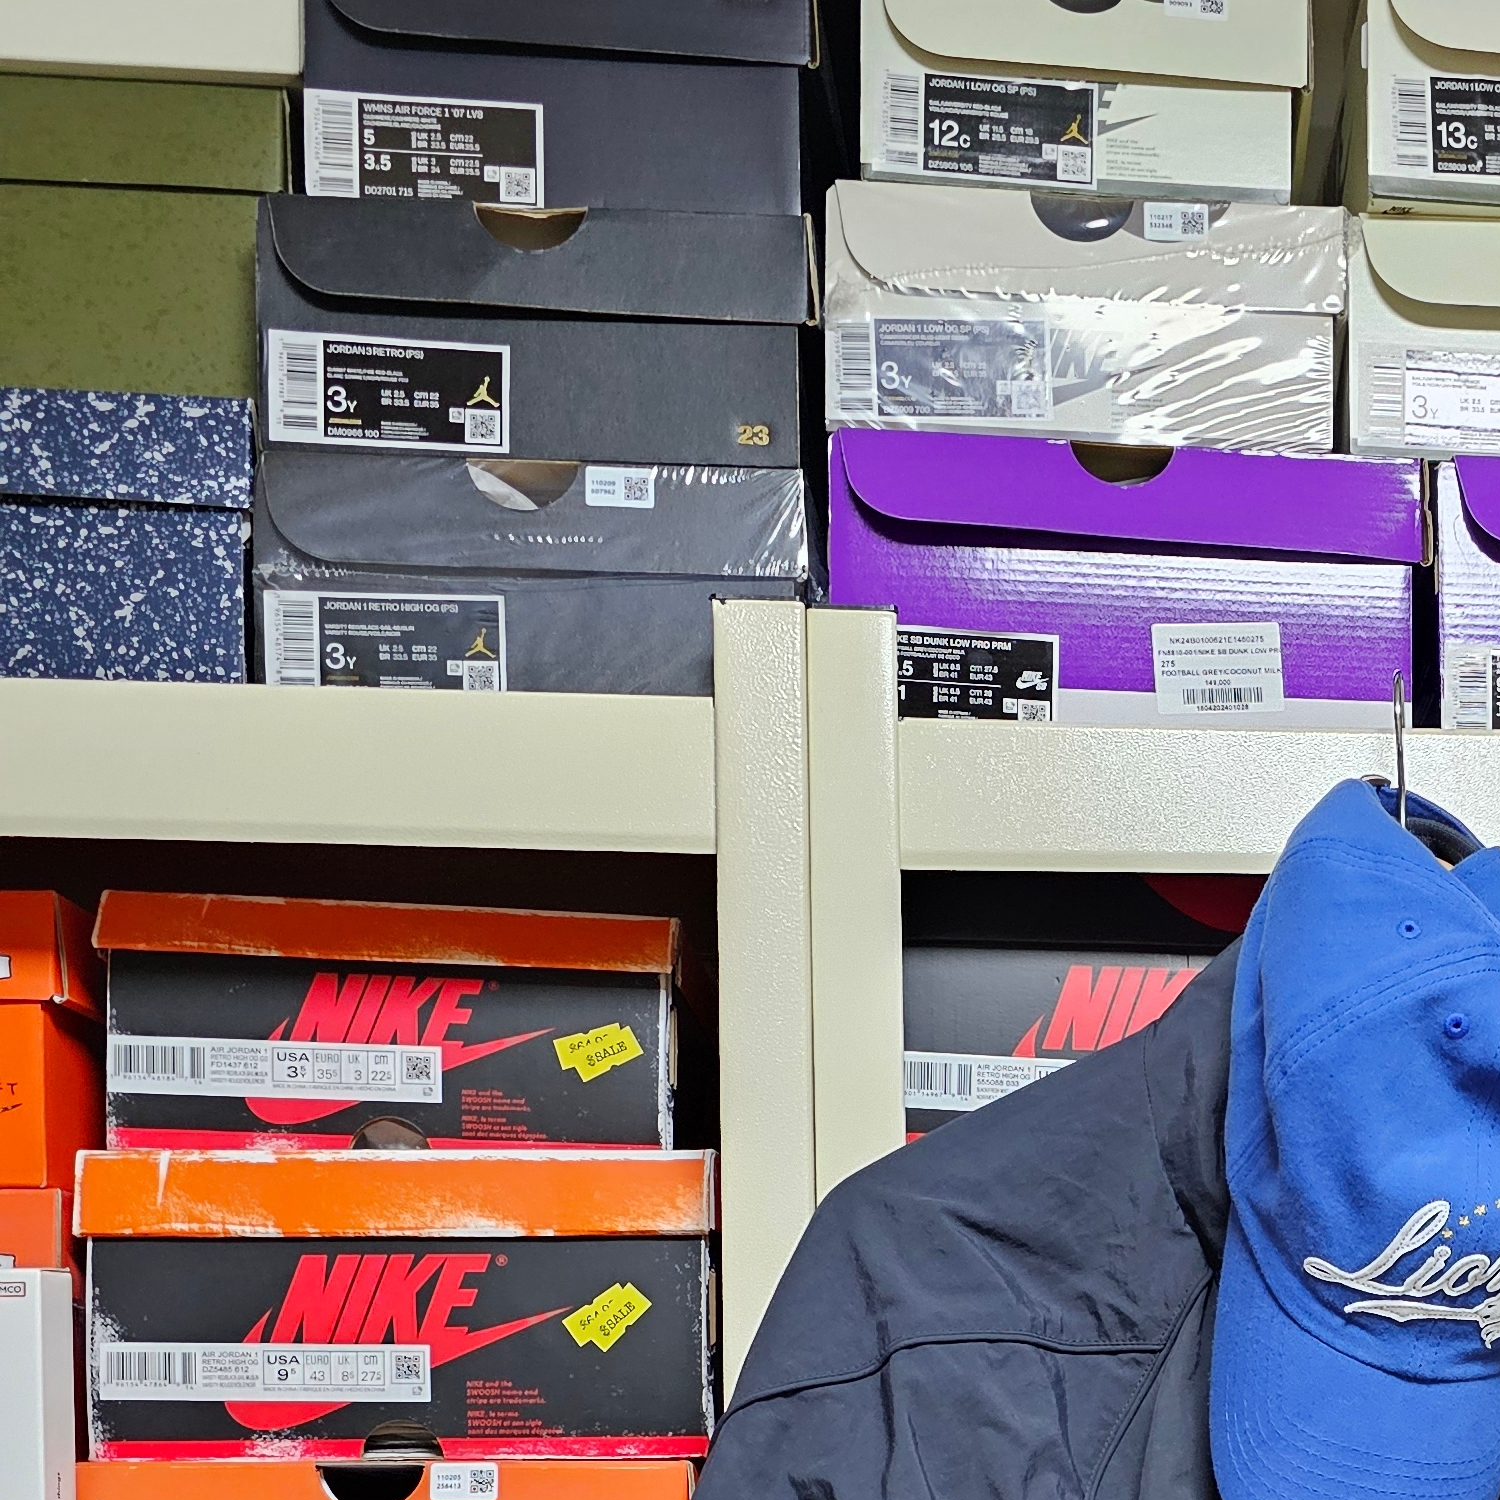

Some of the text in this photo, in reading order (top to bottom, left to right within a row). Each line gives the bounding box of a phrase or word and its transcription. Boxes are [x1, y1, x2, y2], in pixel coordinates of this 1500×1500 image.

[929, 78, 964, 90] JORDAN
[966, 81, 970, 90] 1
[971, 82, 990, 92] LOW
[992, 85, 1005, 93] OG
[363, 103, 393, 114] WMNS
[395, 106, 410, 115] AIR
[412, 107, 442, 117] FORCE
[364, 129, 375, 145] 5
[364, 154, 391, 171] 3.5
[327, 344, 365, 357] JORDAN
[373, 348, 405, 358] RETRO
[738, 425, 769, 445] 23
[324, 601, 361, 611] JORDAN
[369, 602, 400, 611] RETRO
[402, 604, 423, 612] HIGH
[426, 604, 439, 613] OG
[897, 635, 908, 643] KE
[924, 638, 948, 646] DUNK
[950, 639, 969, 648] LOW
[972, 640, 990, 649] PRO
[992, 642, 1011, 650] PRM
[286, 973, 485, 1046] NIKE
[1042, 965, 1204, 1050] NIK
[210, 1046, 225, 1054] AIR
[227, 1047, 261, 1055] JORDAN
[276, 1052, 360, 1064] USA EURO UK
[271, 1253, 492, 1344] NIKE
[267, 1354, 350, 1366] USA EURO UK
[309, 1370, 325, 1382] 43
